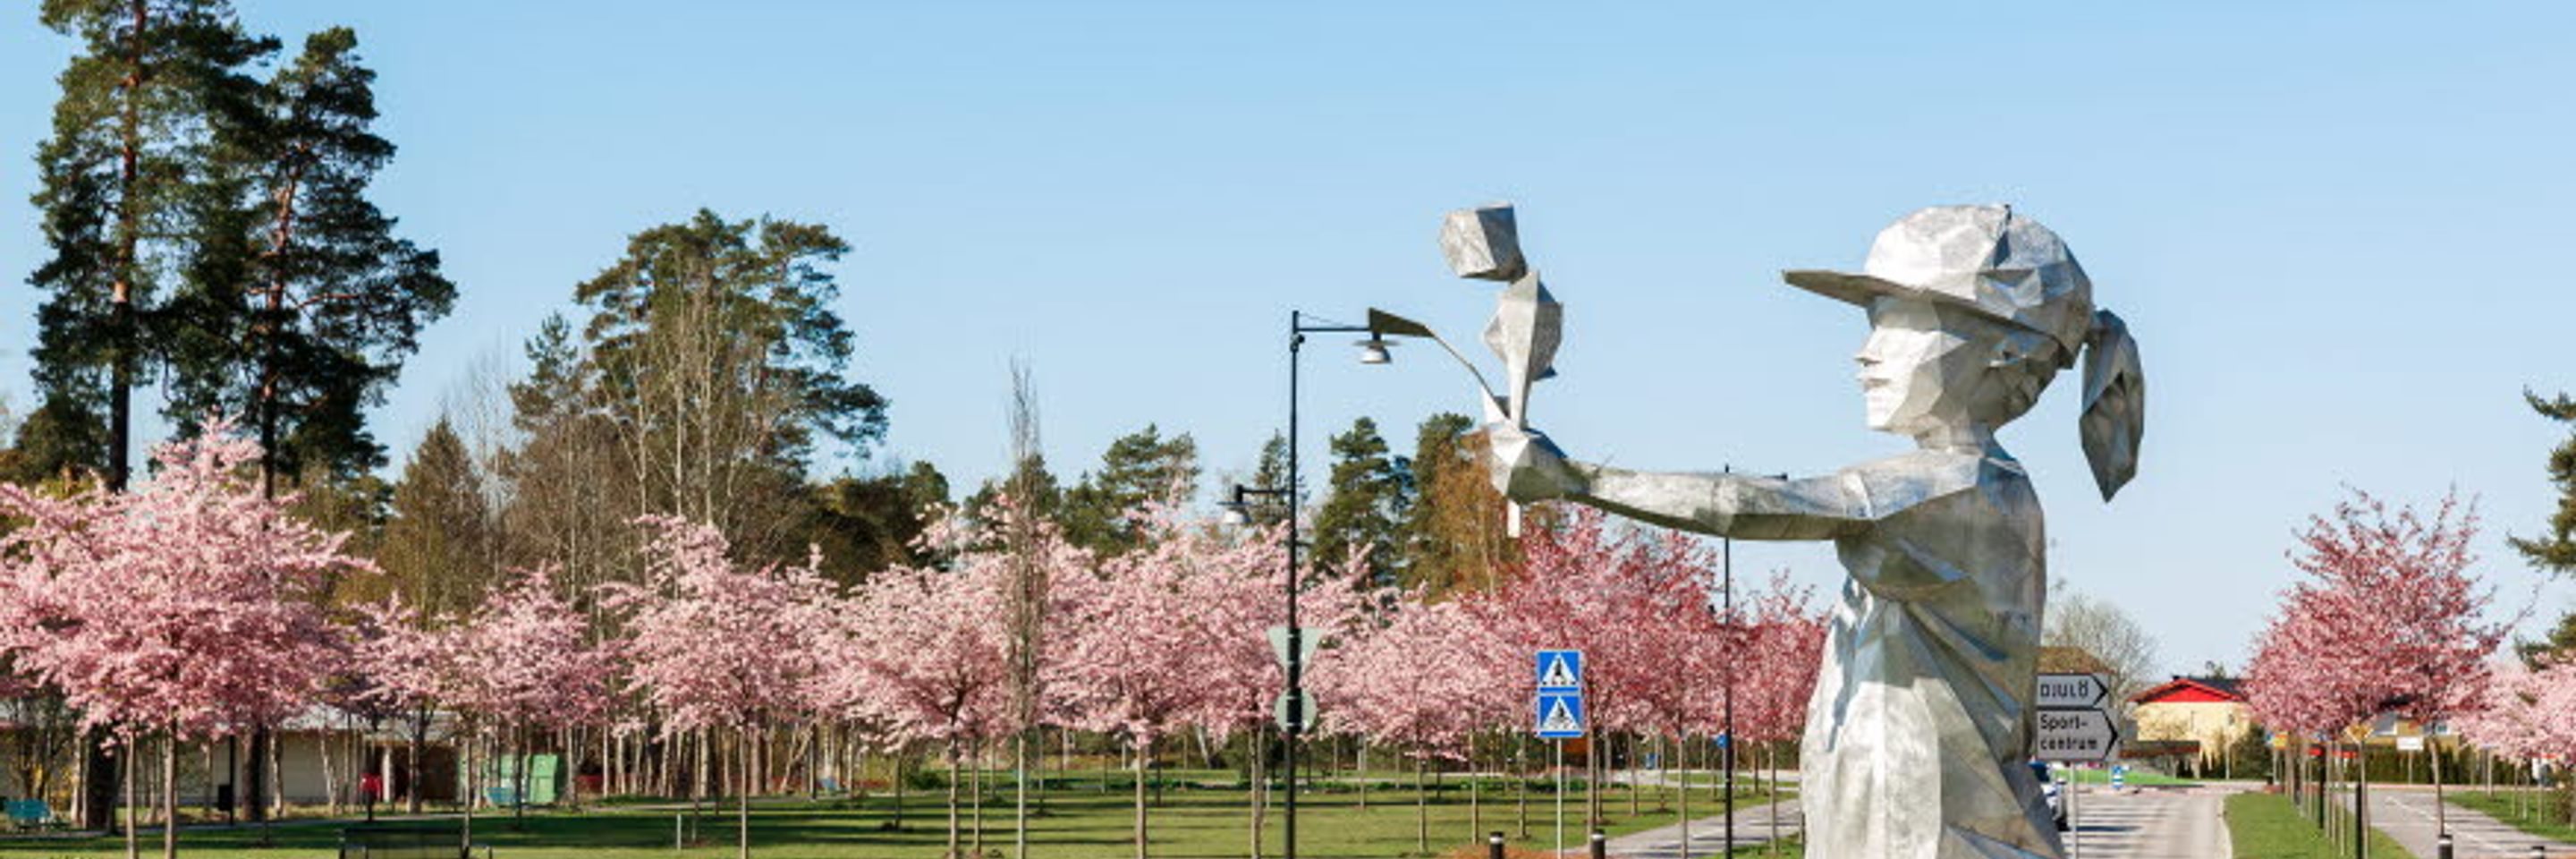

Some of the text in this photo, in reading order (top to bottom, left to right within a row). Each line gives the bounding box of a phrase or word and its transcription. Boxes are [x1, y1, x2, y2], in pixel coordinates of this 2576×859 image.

[2040, 680, 2089, 698] DJULÖ
[2040, 714, 2089, 732] Sport-
[2040, 737, 2098, 750] centrum
